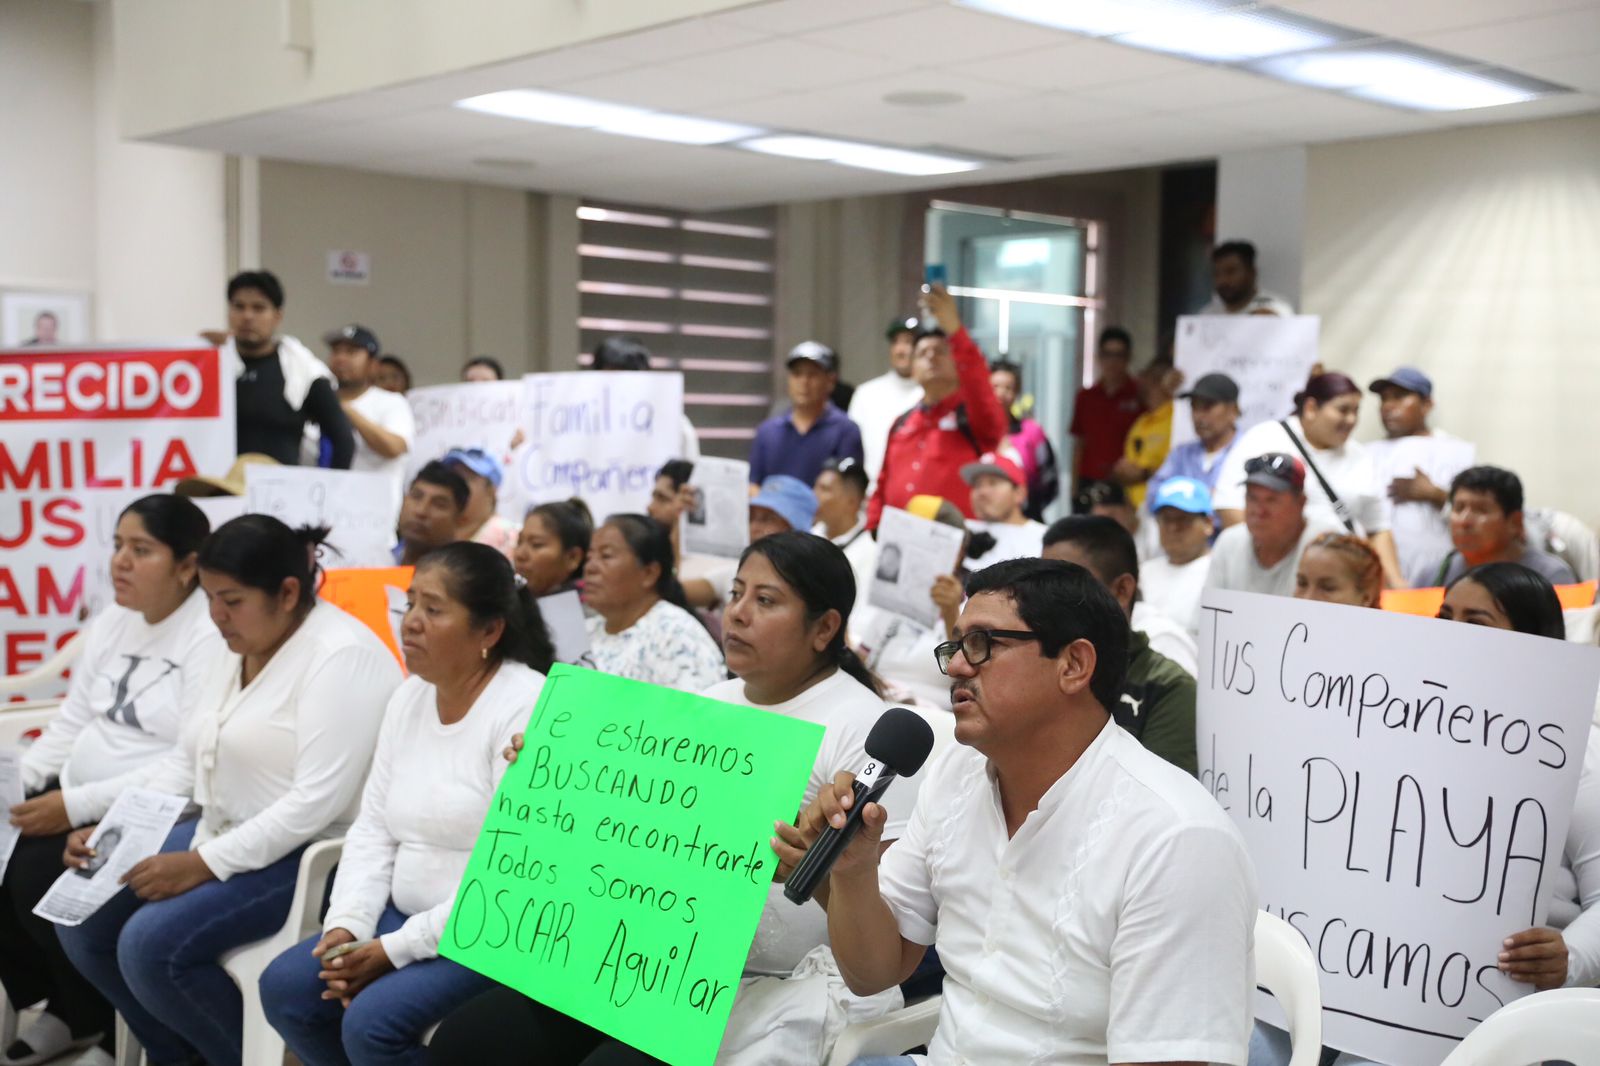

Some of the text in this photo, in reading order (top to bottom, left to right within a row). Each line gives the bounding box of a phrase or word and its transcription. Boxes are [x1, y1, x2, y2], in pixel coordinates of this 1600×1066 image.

[534, 673, 755, 776] Te estaremos
[527, 744, 698, 810] BUSCANDO
[863, 762, 876, 776] 8
[485, 827, 558, 885] Todos
[594, 816, 764, 885] encontrarte
[1247, 752, 1273, 823] la
[1301, 756, 1548, 926] PLAYA
[453, 878, 730, 1016] OSCAR Aguilar
